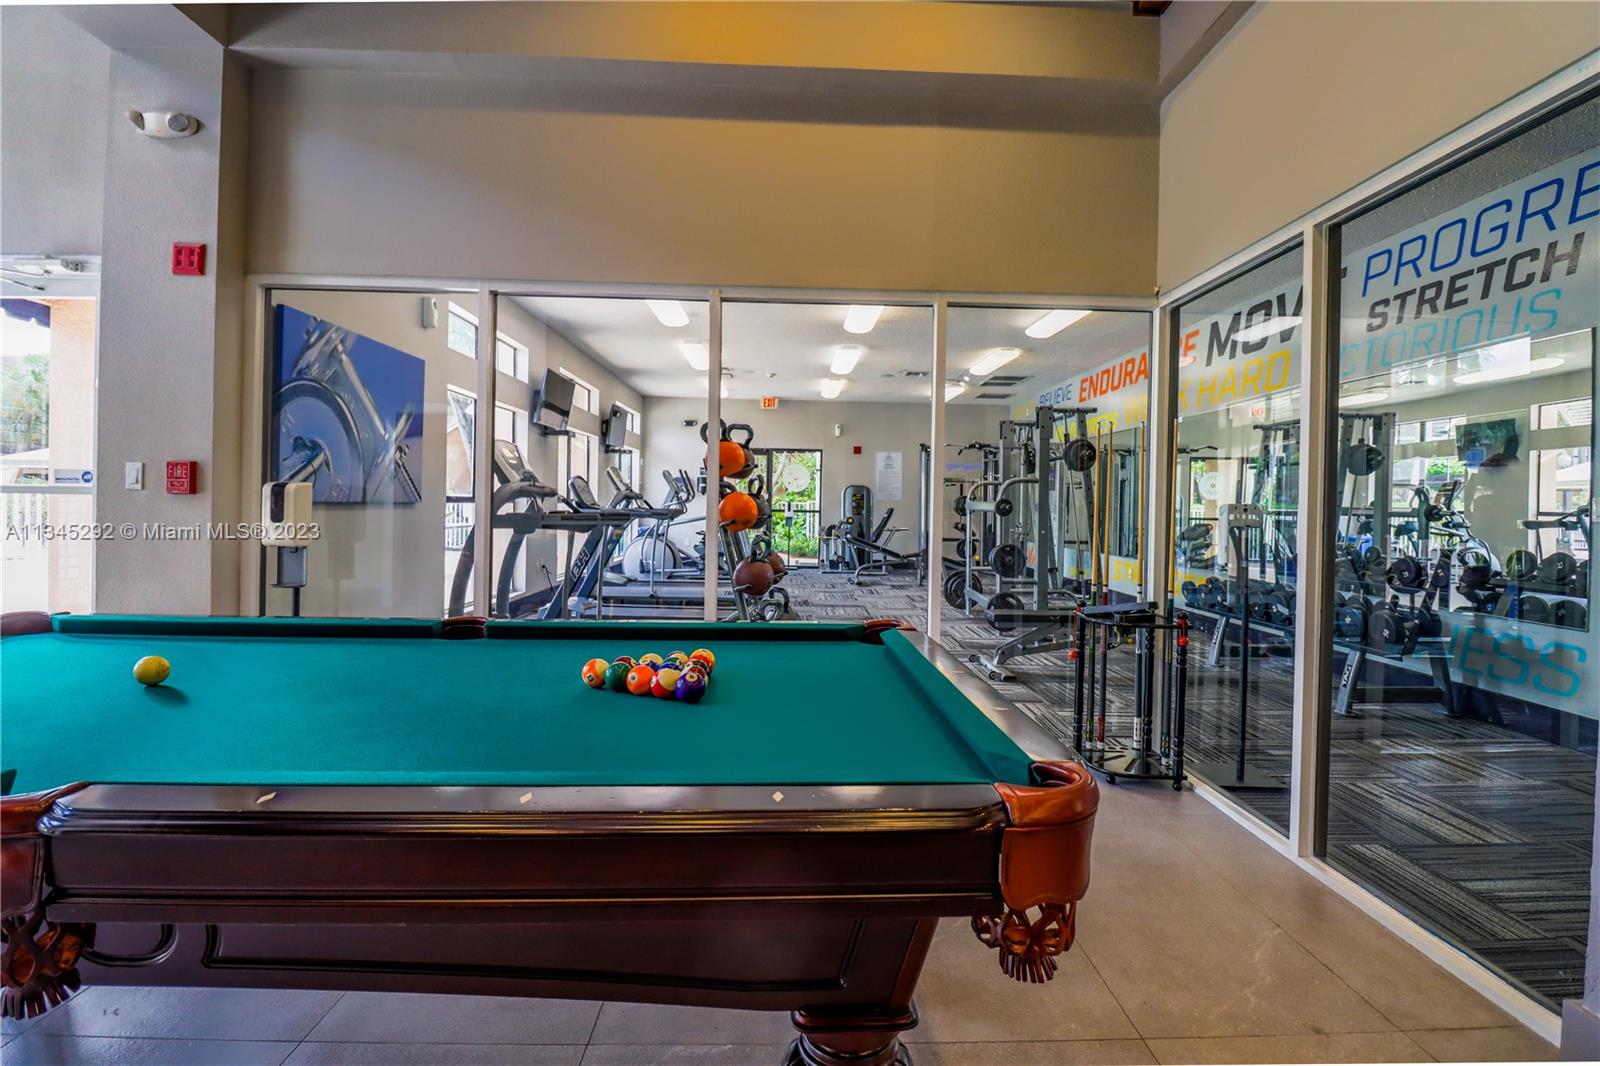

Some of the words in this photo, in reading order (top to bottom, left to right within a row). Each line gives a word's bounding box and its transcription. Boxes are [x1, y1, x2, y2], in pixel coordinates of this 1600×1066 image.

[1366, 231, 1586, 334] STRETCH
[1206, 285, 1304, 367] MOV
[1197, 347, 1292, 408] HARD
[168, 465, 188, 478] FIRE
